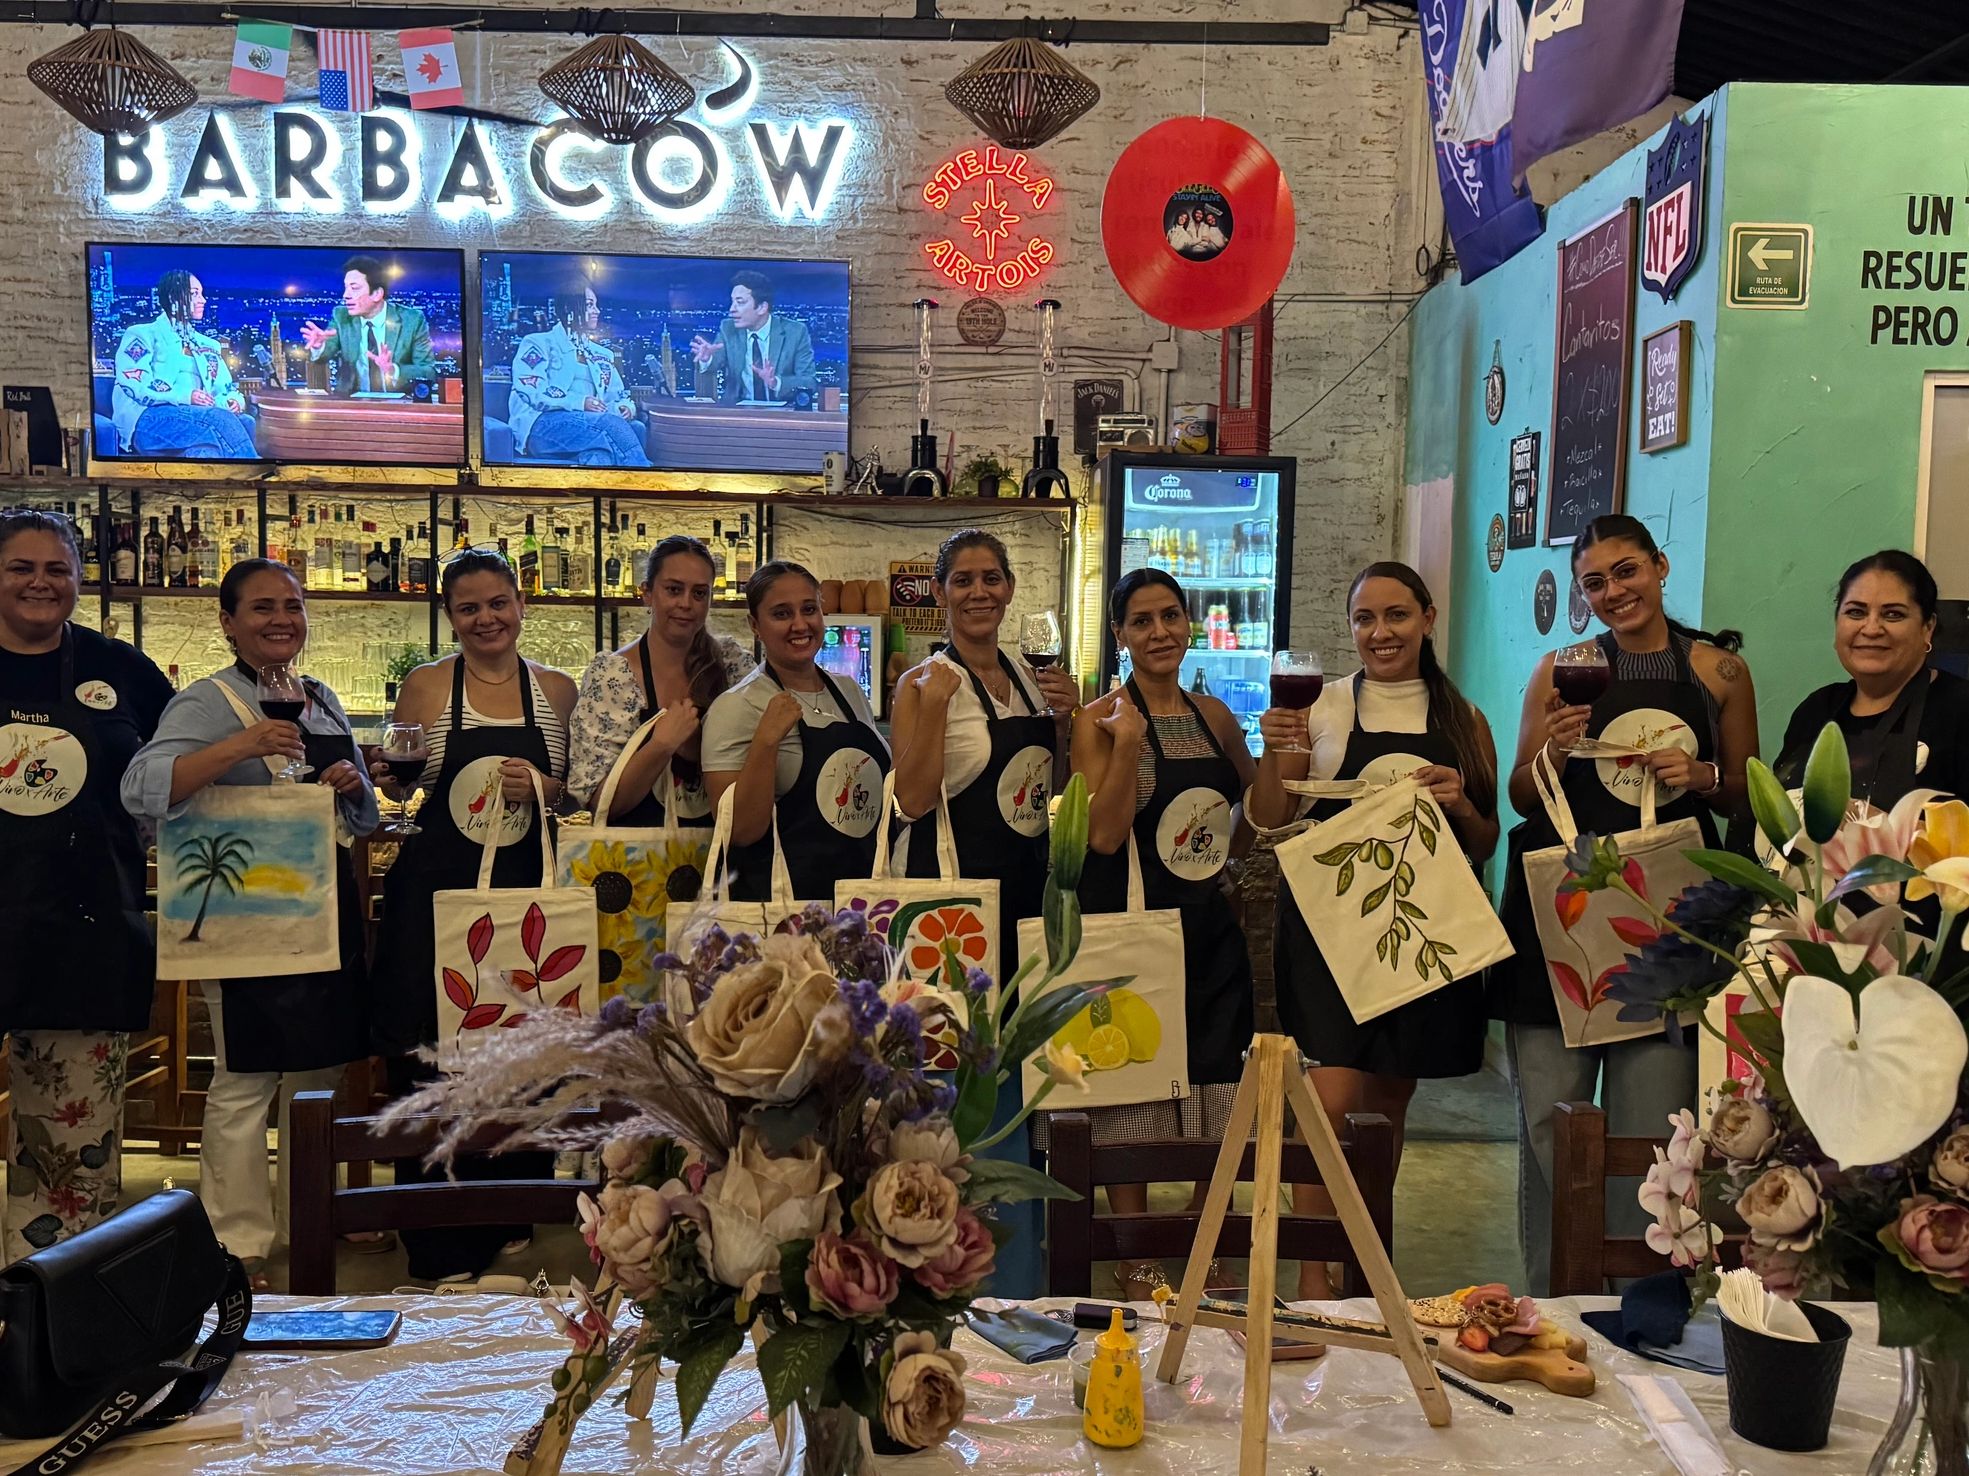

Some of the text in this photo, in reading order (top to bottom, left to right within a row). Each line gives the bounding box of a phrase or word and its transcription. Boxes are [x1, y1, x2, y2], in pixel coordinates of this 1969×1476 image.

[104, 108, 846, 212] BARBACOW
[923, 146, 1054, 209] STELLA
[1646, 191, 1687, 275] NFL
[1907, 196, 1953, 236] UN
[925, 238, 1054, 292] ARTOIS
[1756, 277, 1773, 285] RUTA
[1861, 250, 1969, 291] RESUE
[1562, 302, 1621, 363] Cantaritos
[1870, 305, 1958, 346] PERO
[1651, 344, 1677, 376] Ready
[1654, 380, 1672, 411] Set
[1648, 411, 1675, 440] EAT!
[1144, 484, 1192, 502] Corona
[908, 565, 936, 573] WARNI
[915, 579, 930, 596] NO
[892, 607, 906, 617] TALK
[910, 608, 917, 617] TO
[920, 608, 934, 618] EACH
[11, 710, 49, 723] Martha
[220, 1290, 244, 1335] GUE
[38, 1391, 138, 1475] GUESS
